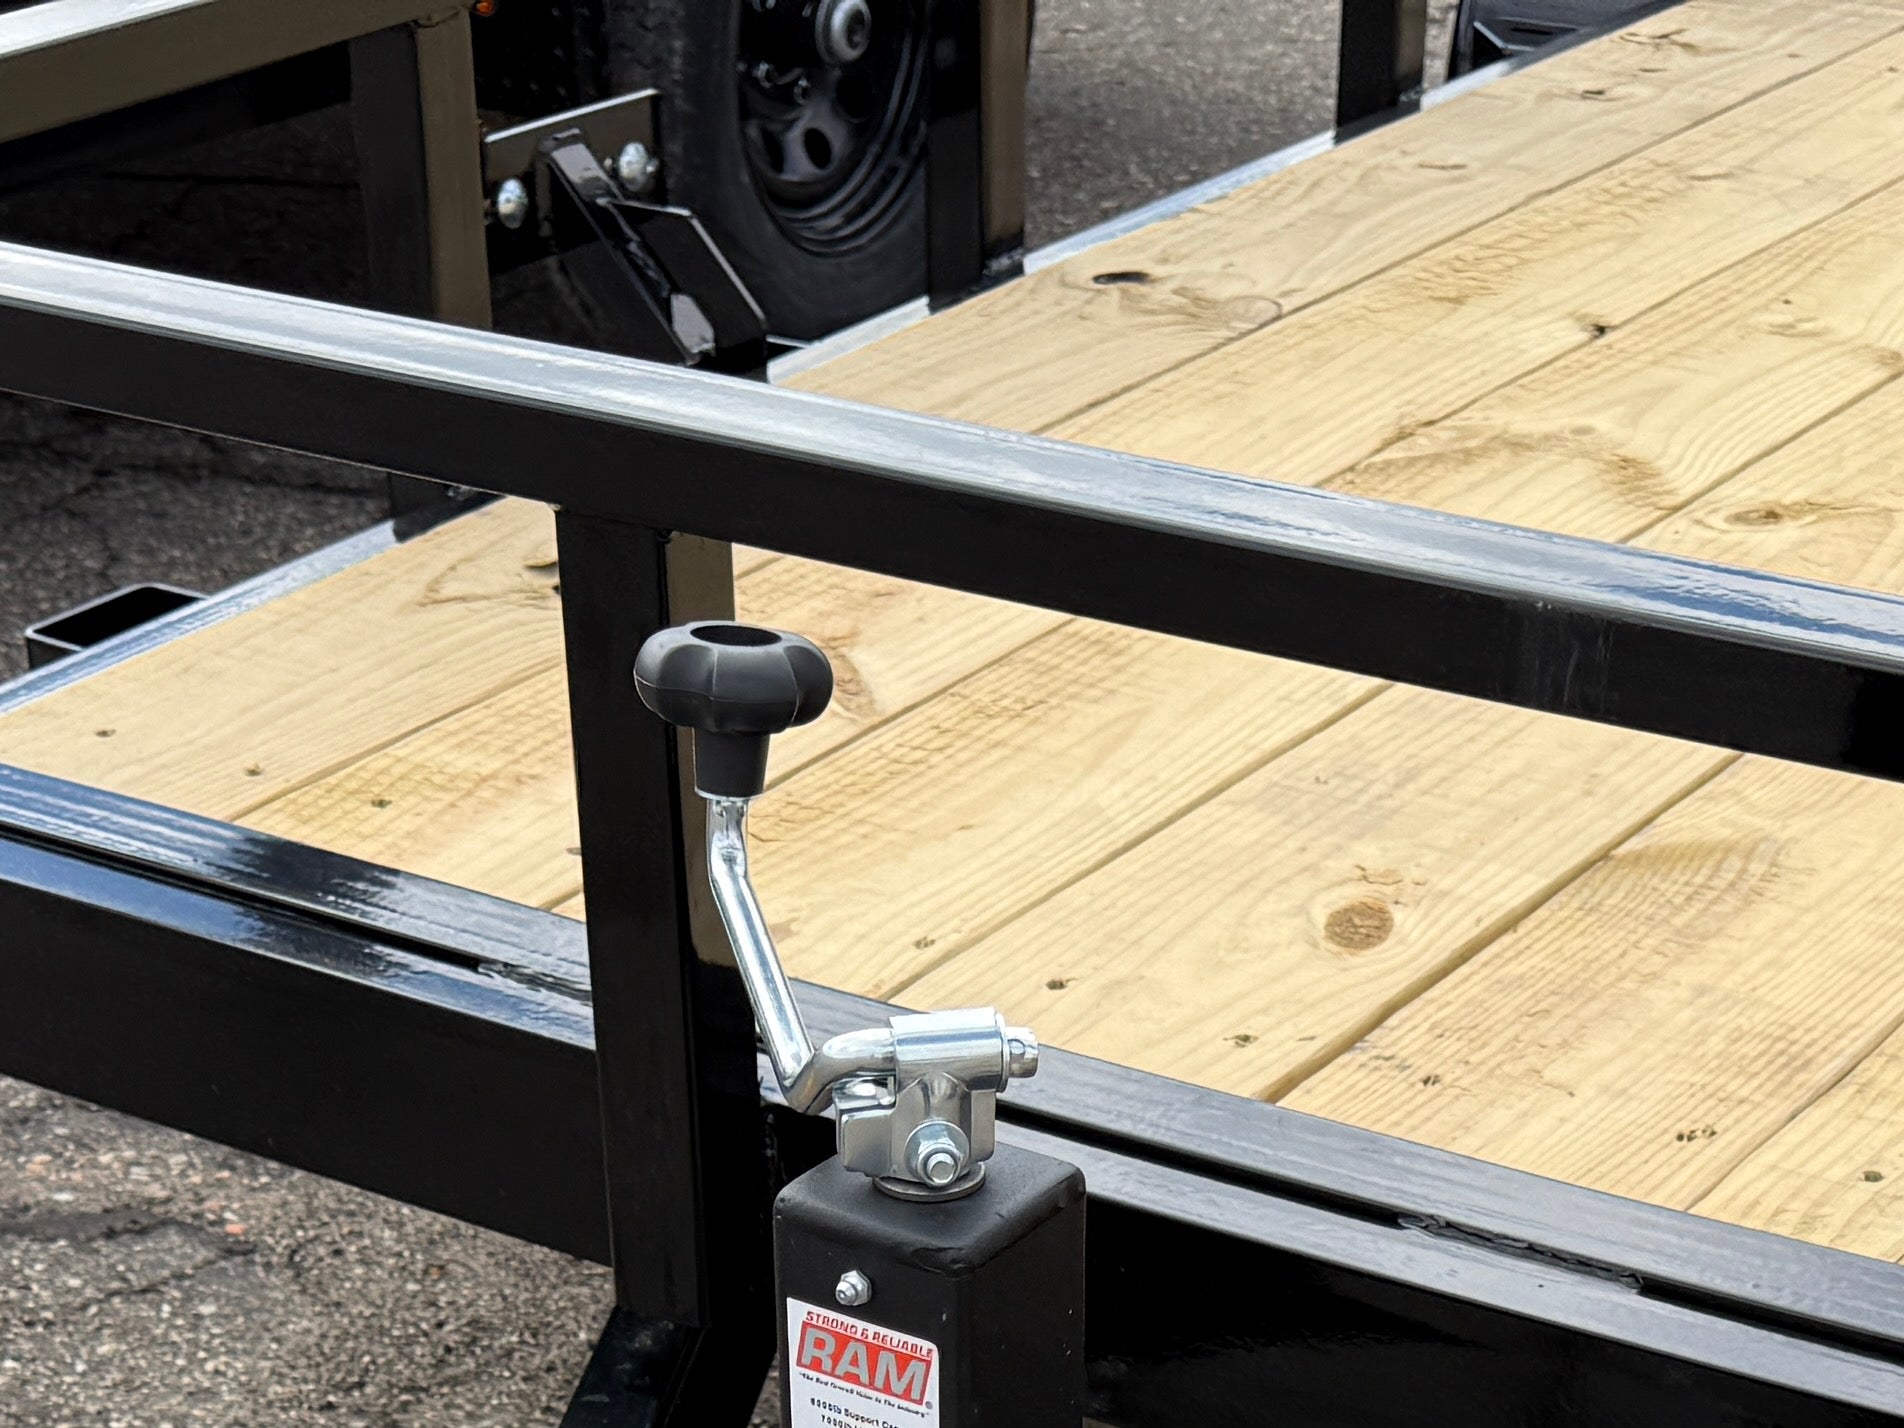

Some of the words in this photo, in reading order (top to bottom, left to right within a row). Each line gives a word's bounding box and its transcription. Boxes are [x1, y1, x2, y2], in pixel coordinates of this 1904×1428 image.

[801, 1327, 927, 1400] RAM
[806, 1310, 858, 1336] STRONG
[872, 1330, 932, 1359] RELIABLE
